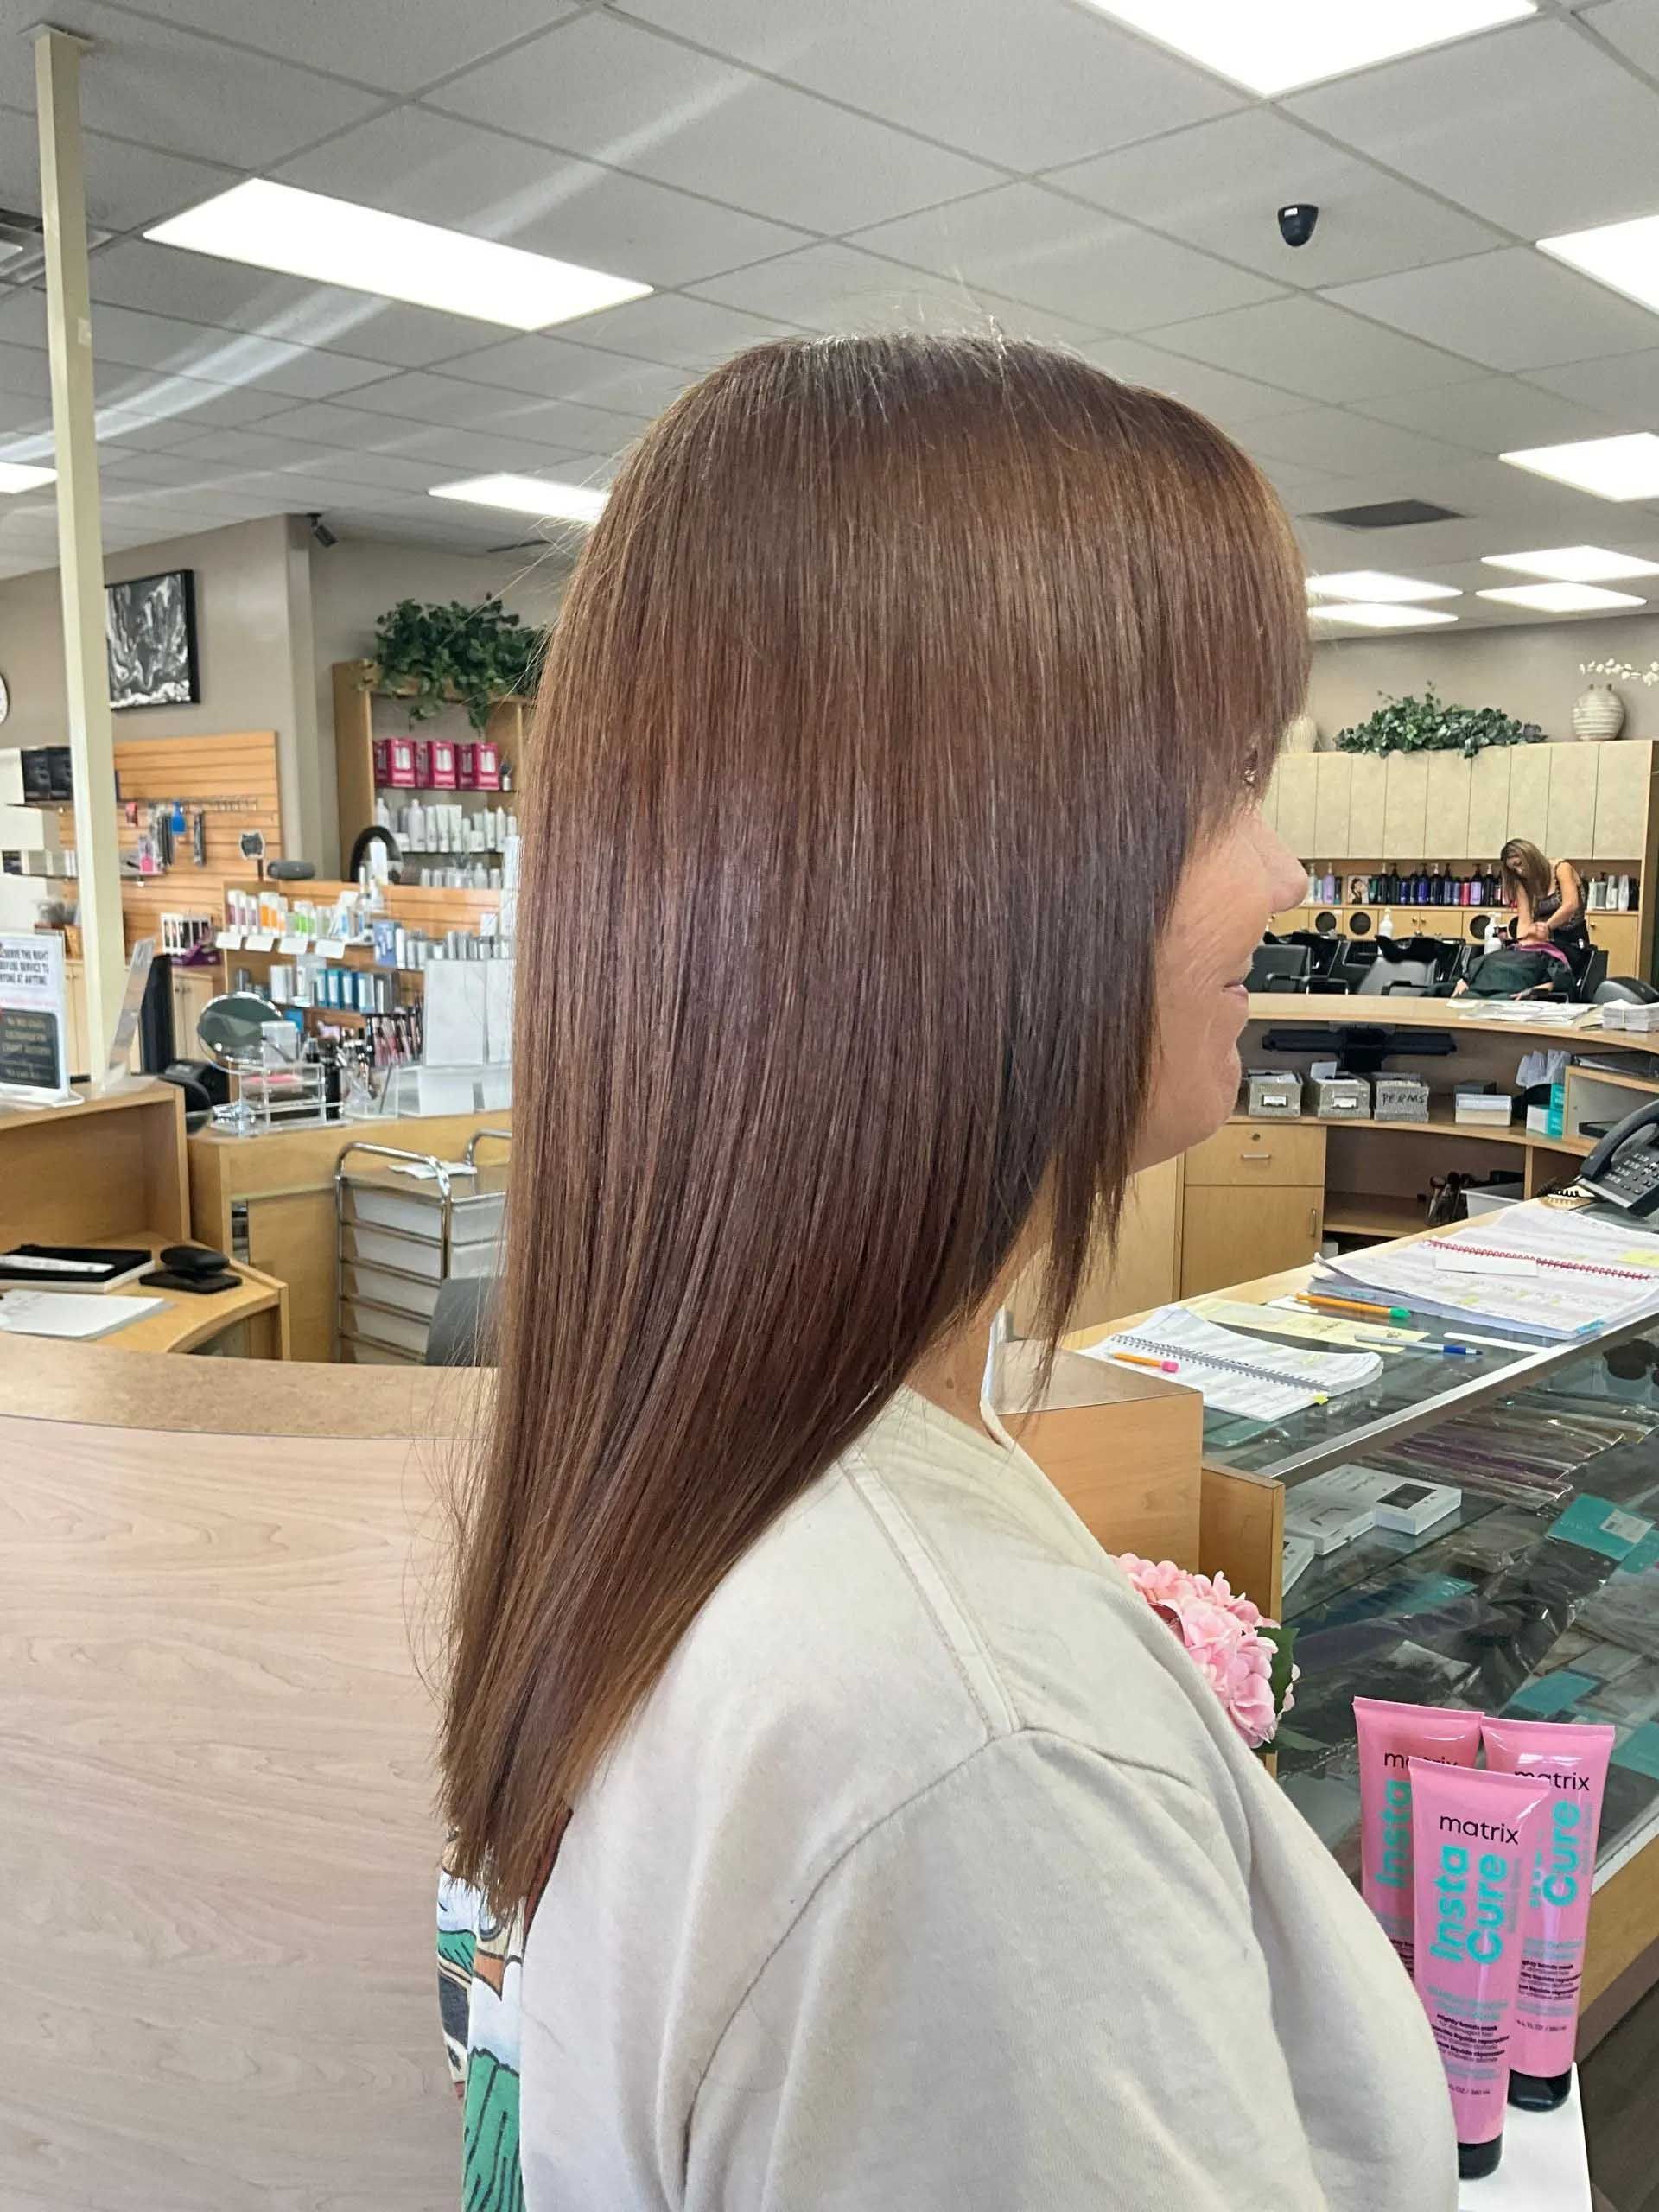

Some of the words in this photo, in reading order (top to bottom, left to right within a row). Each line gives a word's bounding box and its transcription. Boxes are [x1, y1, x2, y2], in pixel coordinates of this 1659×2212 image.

[1382, 1092, 1427, 1106] PERMS
[1375, 1778, 1412, 1888] Insta
[1440, 1815, 1519, 1845] matrix
[1541, 1799, 1581, 1907] Cure
[1430, 1844, 1471, 1964] Insta
[1465, 1853, 1509, 1965] Cure
